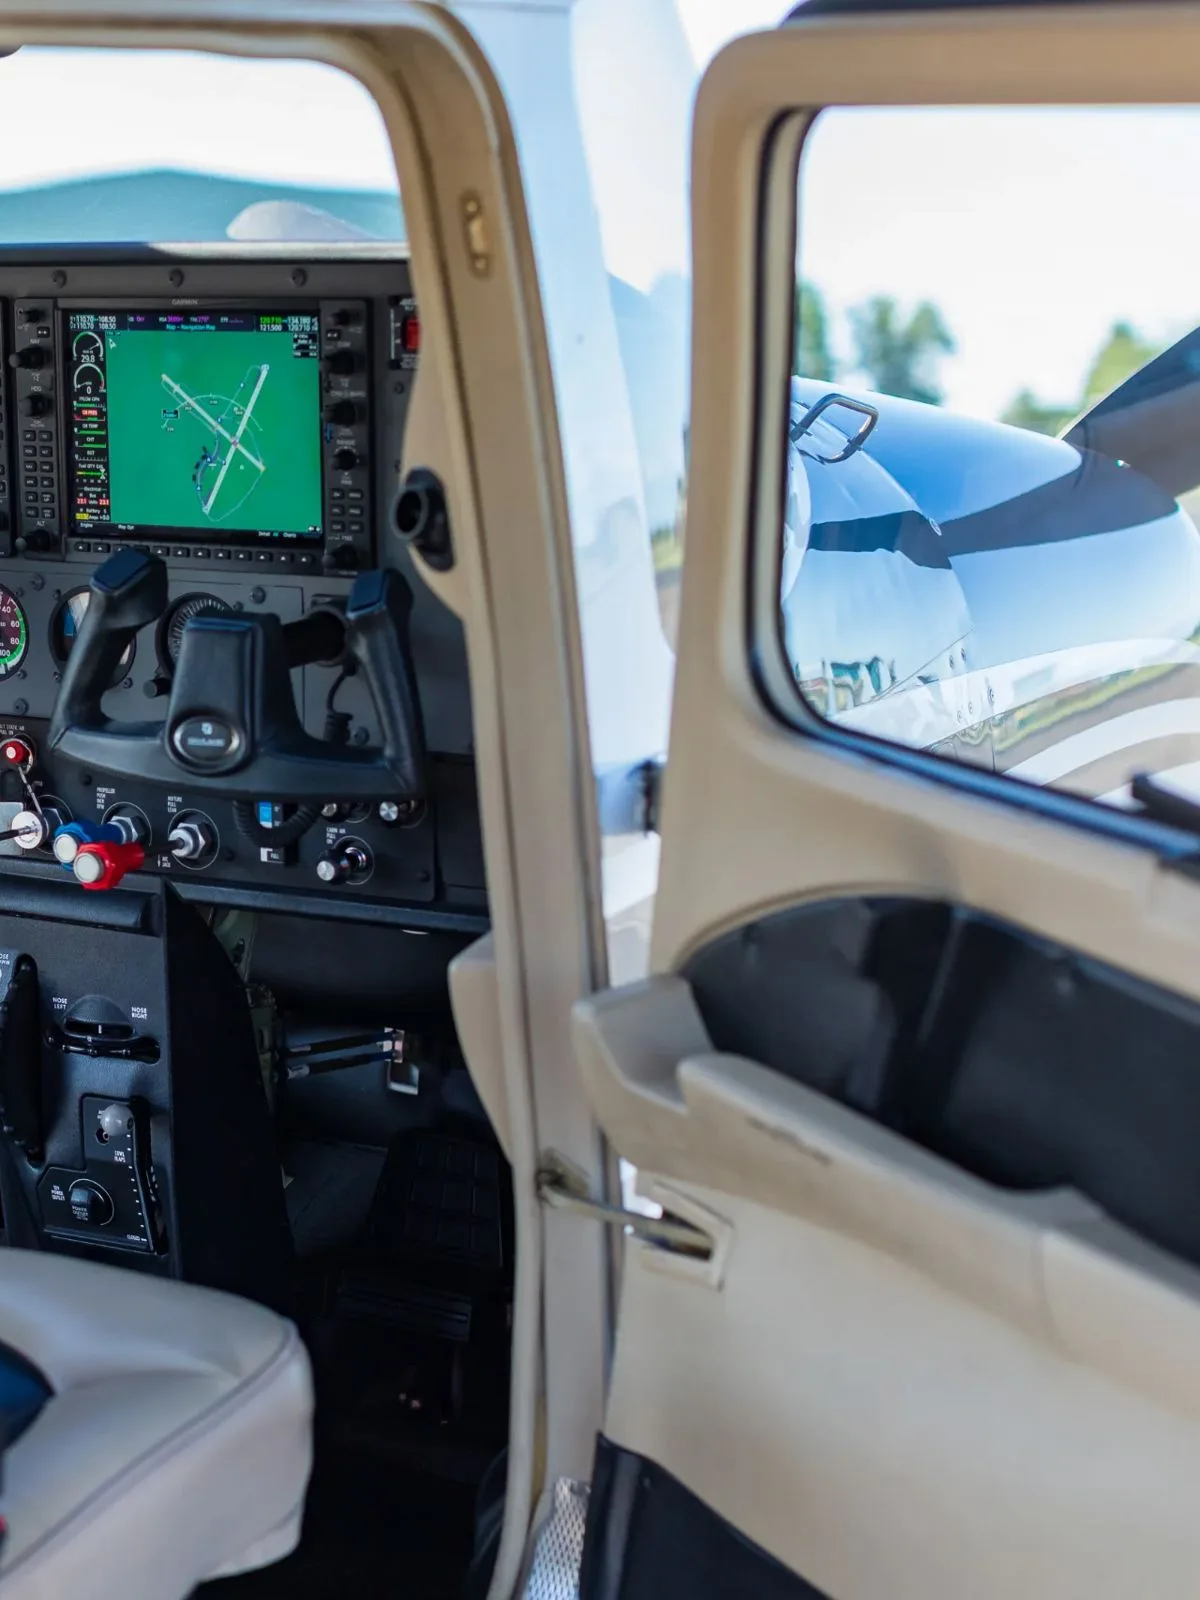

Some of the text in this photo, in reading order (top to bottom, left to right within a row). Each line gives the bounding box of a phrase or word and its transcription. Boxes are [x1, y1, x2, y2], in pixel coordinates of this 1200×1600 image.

[81, 355, 95, 363] 29.8
[10, 620, 19, 628] 60
[10, 637, 19, 645] 80
[131, 1006, 147, 1014] NOSE
[131, 1012, 148, 1020] RIGHT
